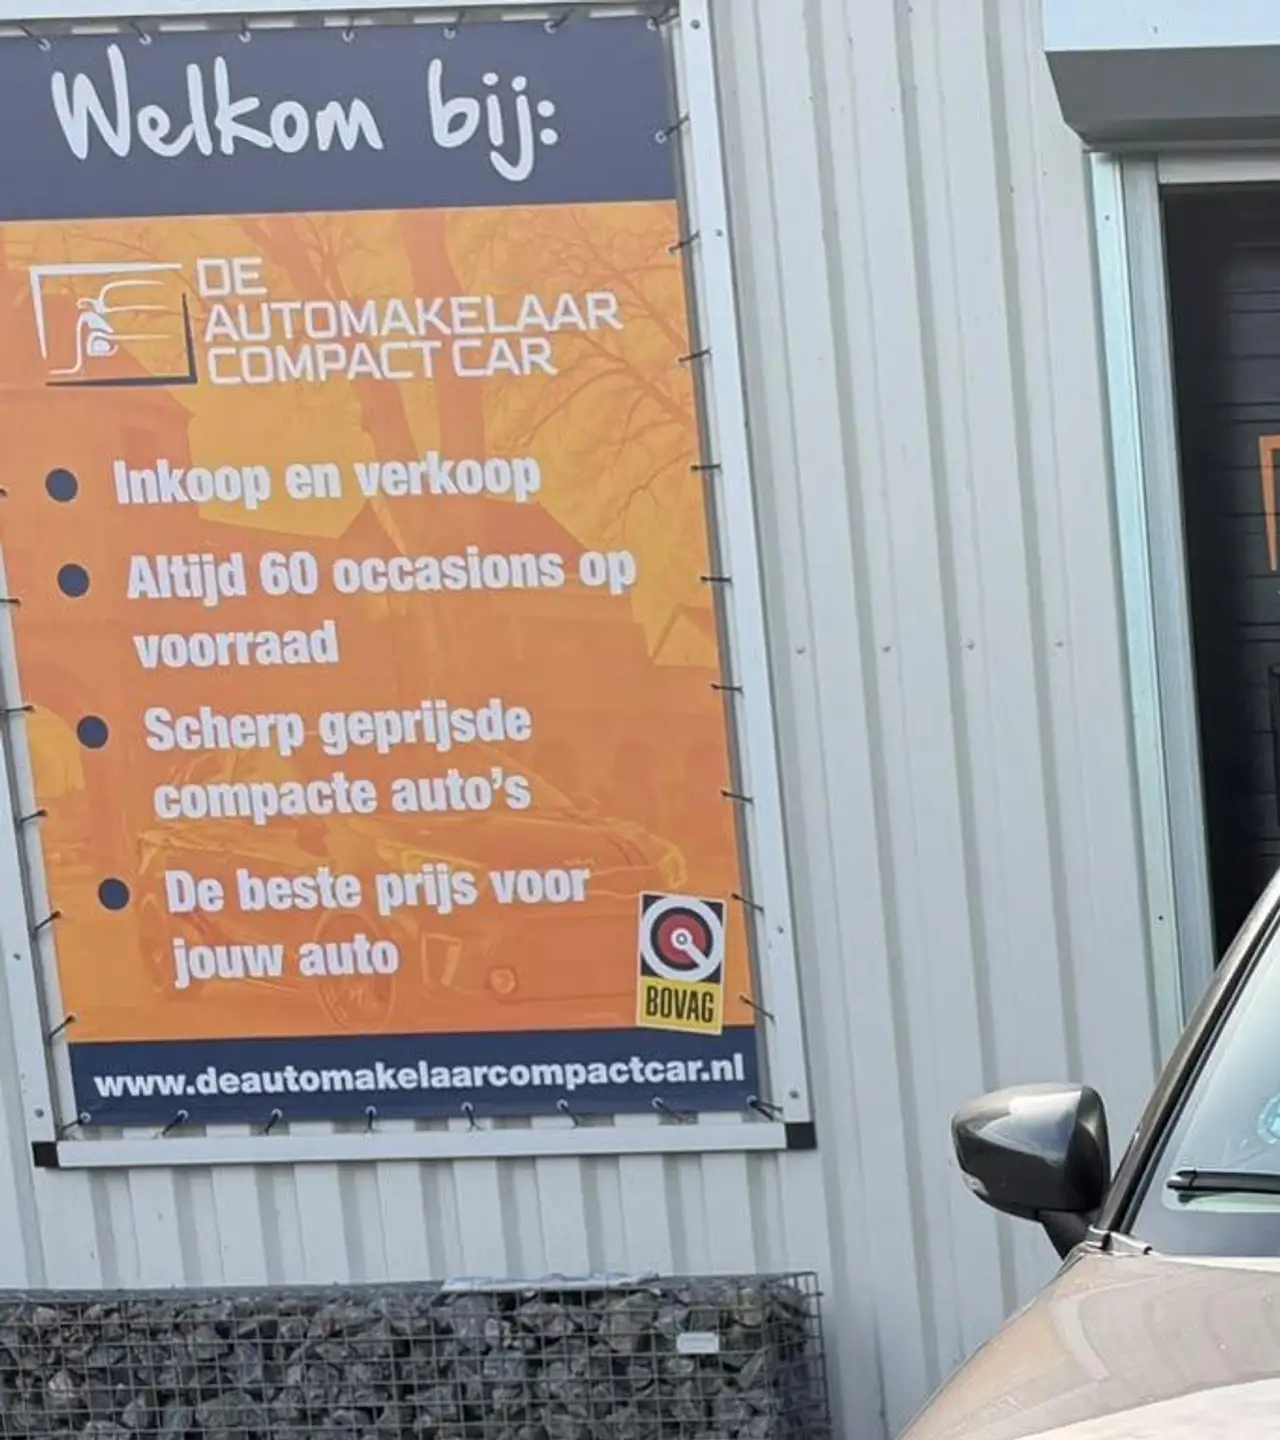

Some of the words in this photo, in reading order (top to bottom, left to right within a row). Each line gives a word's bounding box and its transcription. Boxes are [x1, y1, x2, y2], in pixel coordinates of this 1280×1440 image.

[51, 45, 384, 160] Welkom
[427, 59, 559, 182] bij:
[197, 257, 267, 298] DE
[204, 292, 623, 343] AUTOMAKELAAR
[208, 340, 441, 386] COMPACT
[453, 338, 557, 378] CAR
[113, 459, 271, 510] Inkoop
[284, 461, 341, 499] en
[354, 452, 541, 502] verkoop
[126, 554, 246, 606] Altijd
[260, 551, 319, 594] 60
[334, 546, 565, 592] occasions
[579, 547, 636, 593] op
[133, 620, 339, 669] voorraad
[145, 705, 305, 753] Scherp
[319, 698, 532, 756] geprijsde
[153, 774, 378, 825] compacte
[391, 767, 531, 813] auto's
[164, 868, 224, 914] De
[238, 866, 363, 912] beste
[376, 866, 478, 916] prijs
[488, 863, 589, 905] voor
[173, 935, 283, 989] jouw
[298, 932, 399, 976] auto
[644, 985, 714, 1024] BOVAG
[94, 1053, 746, 1099] www.deautomakelaarcompactcar.nl
